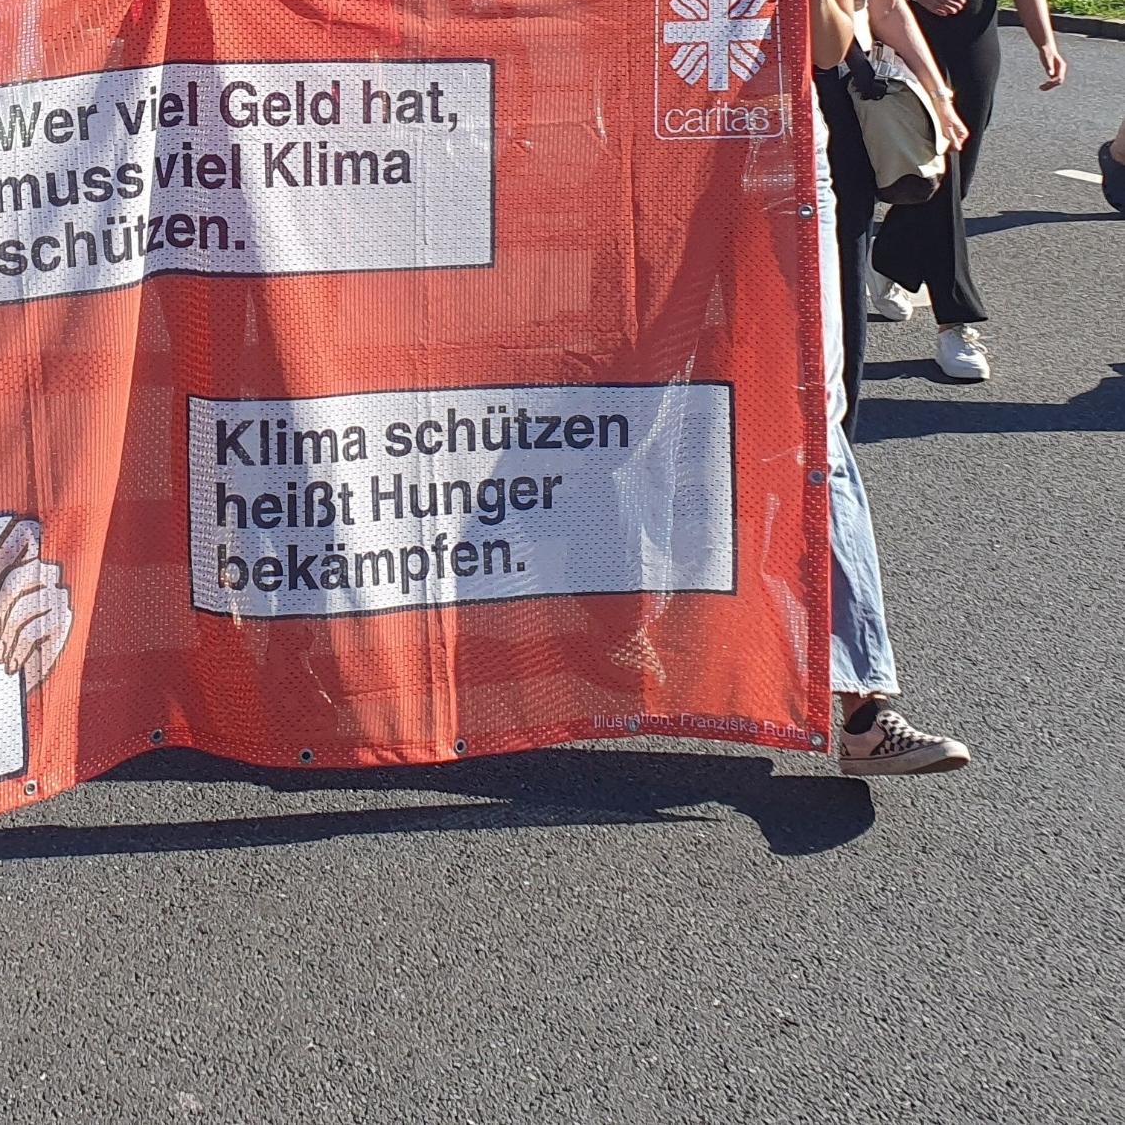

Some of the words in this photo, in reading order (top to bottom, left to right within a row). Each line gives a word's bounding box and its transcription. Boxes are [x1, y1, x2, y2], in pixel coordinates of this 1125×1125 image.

[116, 81, 198, 135] viel
[219, 80, 340, 129] Geld
[361, 79, 459, 131] hat,
[664, 99, 770, 134] caritas
[154, 141, 241, 190] viel
[263, 140, 413, 189] Klima
[216, 418, 368, 467] Klima
[384, 407, 630, 456] schützen
[216, 478, 357, 530] heißt
[370, 473, 564, 526] Hunger
[216, 531, 528, 595] bekämpfen.
[679, 712, 758, 733] Franziska
